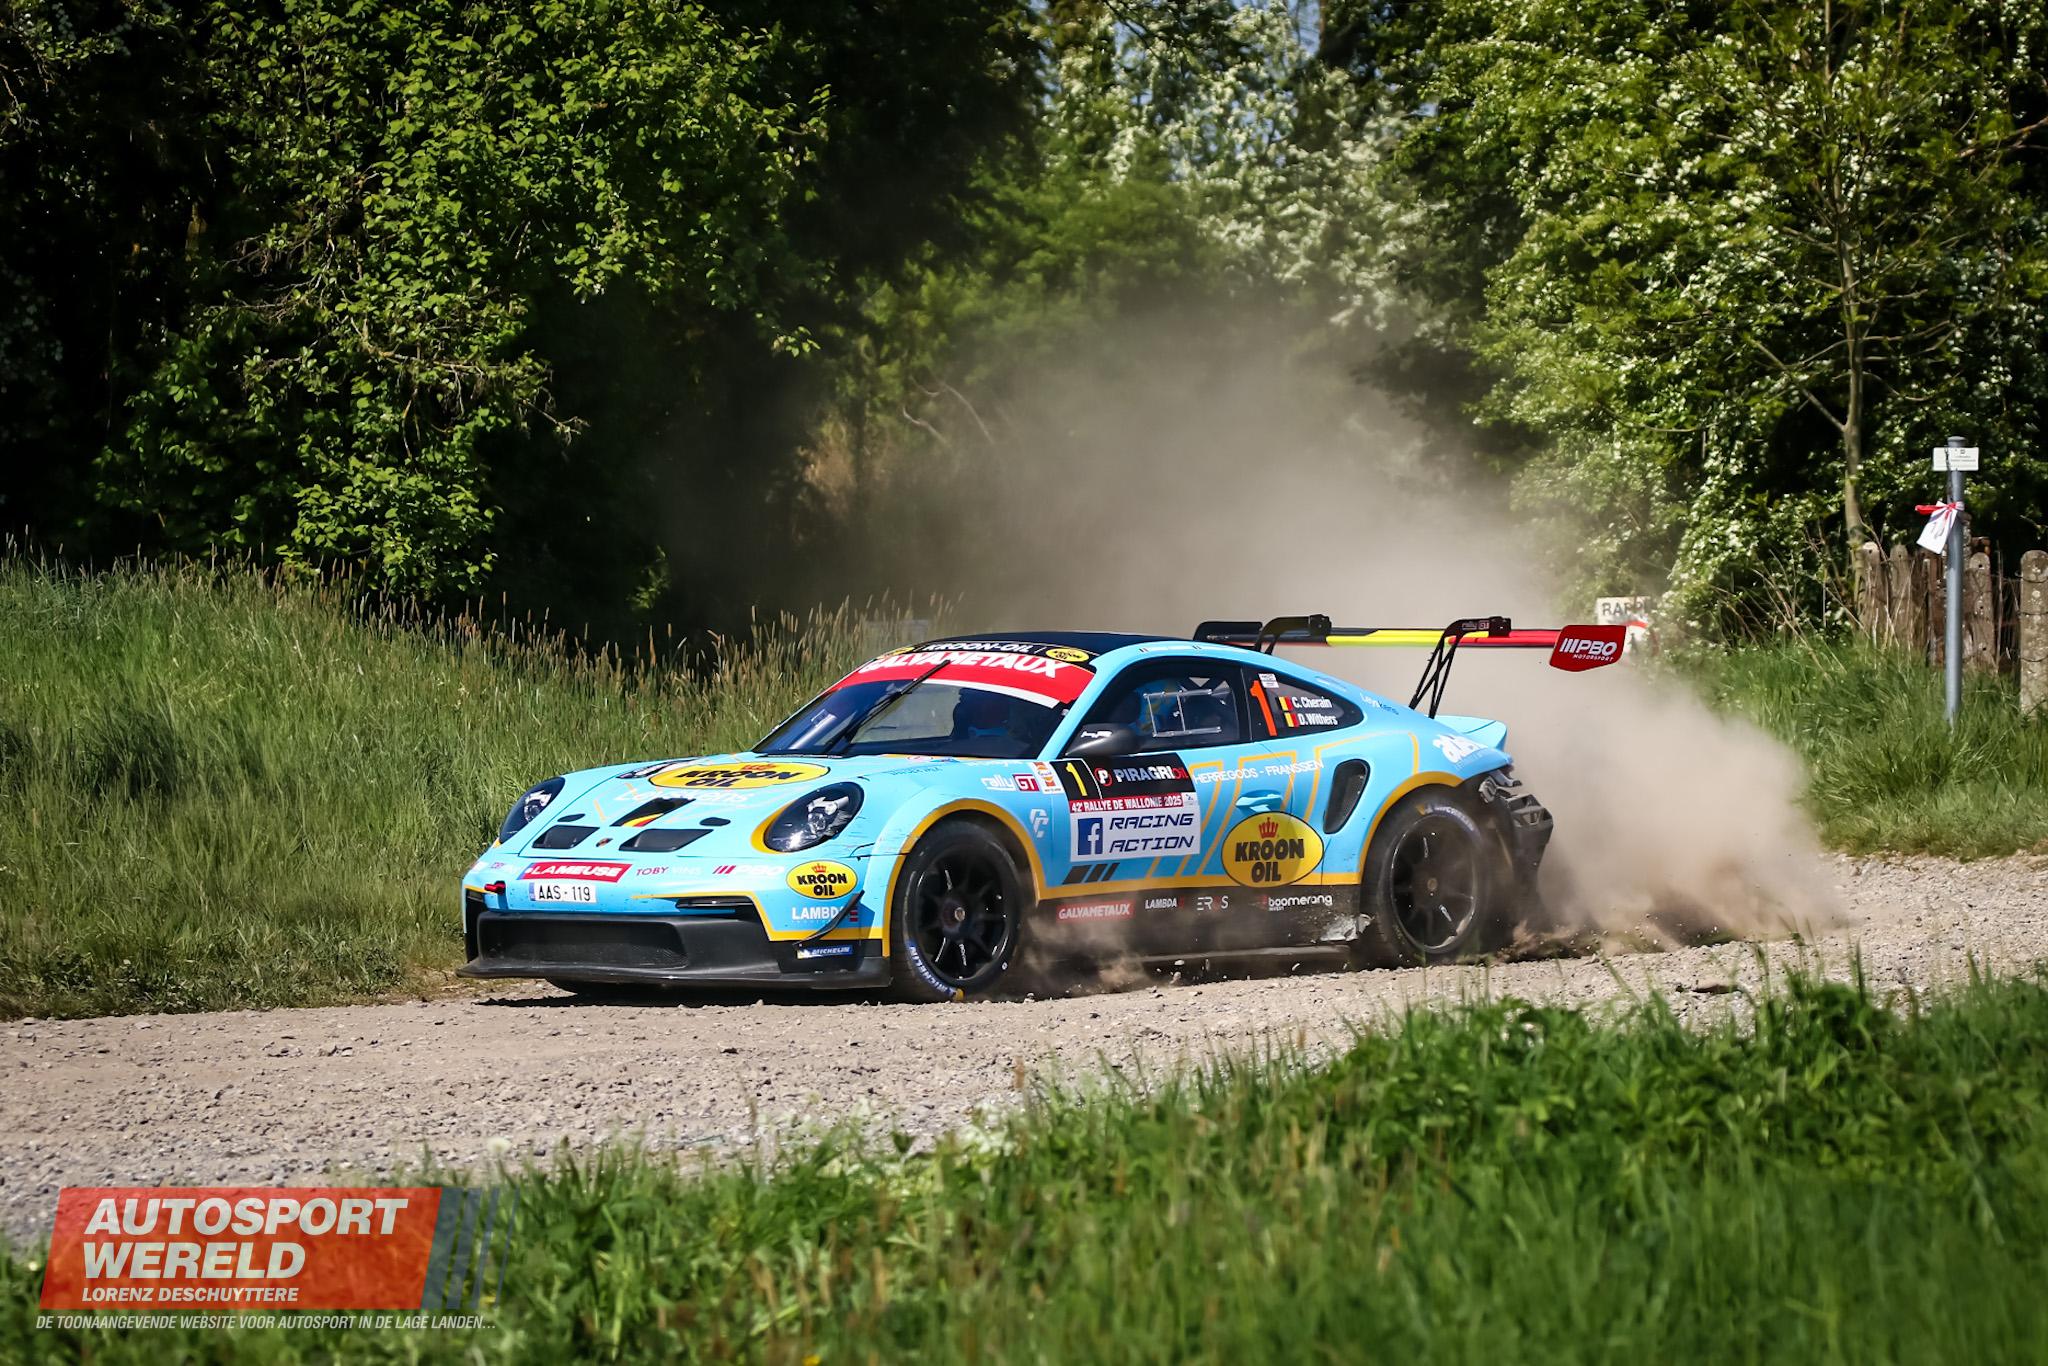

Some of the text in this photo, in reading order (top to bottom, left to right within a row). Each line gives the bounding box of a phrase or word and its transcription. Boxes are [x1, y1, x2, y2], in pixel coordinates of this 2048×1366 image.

[923, 642, 1035, 654] KROON-OIL
[858, 650, 1071, 678] GALVAMETAUX
[1572, 653, 1614, 662] MOTORSPORT
[1250, 680, 1278, 737] 1
[1301, 695, 1333, 708] Cherain
[677, 769, 804, 780] KROON
[1065, 762, 1088, 797] 1
[1195, 767, 1258, 785] HERREGODS
[1265, 760, 1325, 777] FRANSSEN
[685, 778, 741, 788] OIL
[981, 774, 1038, 791] rally GT
[1083, 801, 1113, 812] RALLYE
[1113, 800, 1124, 810] DE
[1125, 797, 1162, 810] WALLONIE
[1163, 795, 1183, 807] 2025
[1109, 813, 1195, 830] RACING
[1109, 836, 1195, 853] ACTION
[1235, 839, 1305, 862] KROON
[637, 867, 669, 876] TOBY
[1251, 862, 1282, 883] OIL
[796, 873, 848, 885] KROON
[812, 884, 836, 897] OIL
[1145, 898, 1177, 909] LAMBDA
[1268, 894, 1333, 907] boomerang
[1059, 903, 1130, 919] GALVAMETAUX
[811, 946, 851, 955] MICHELIN
